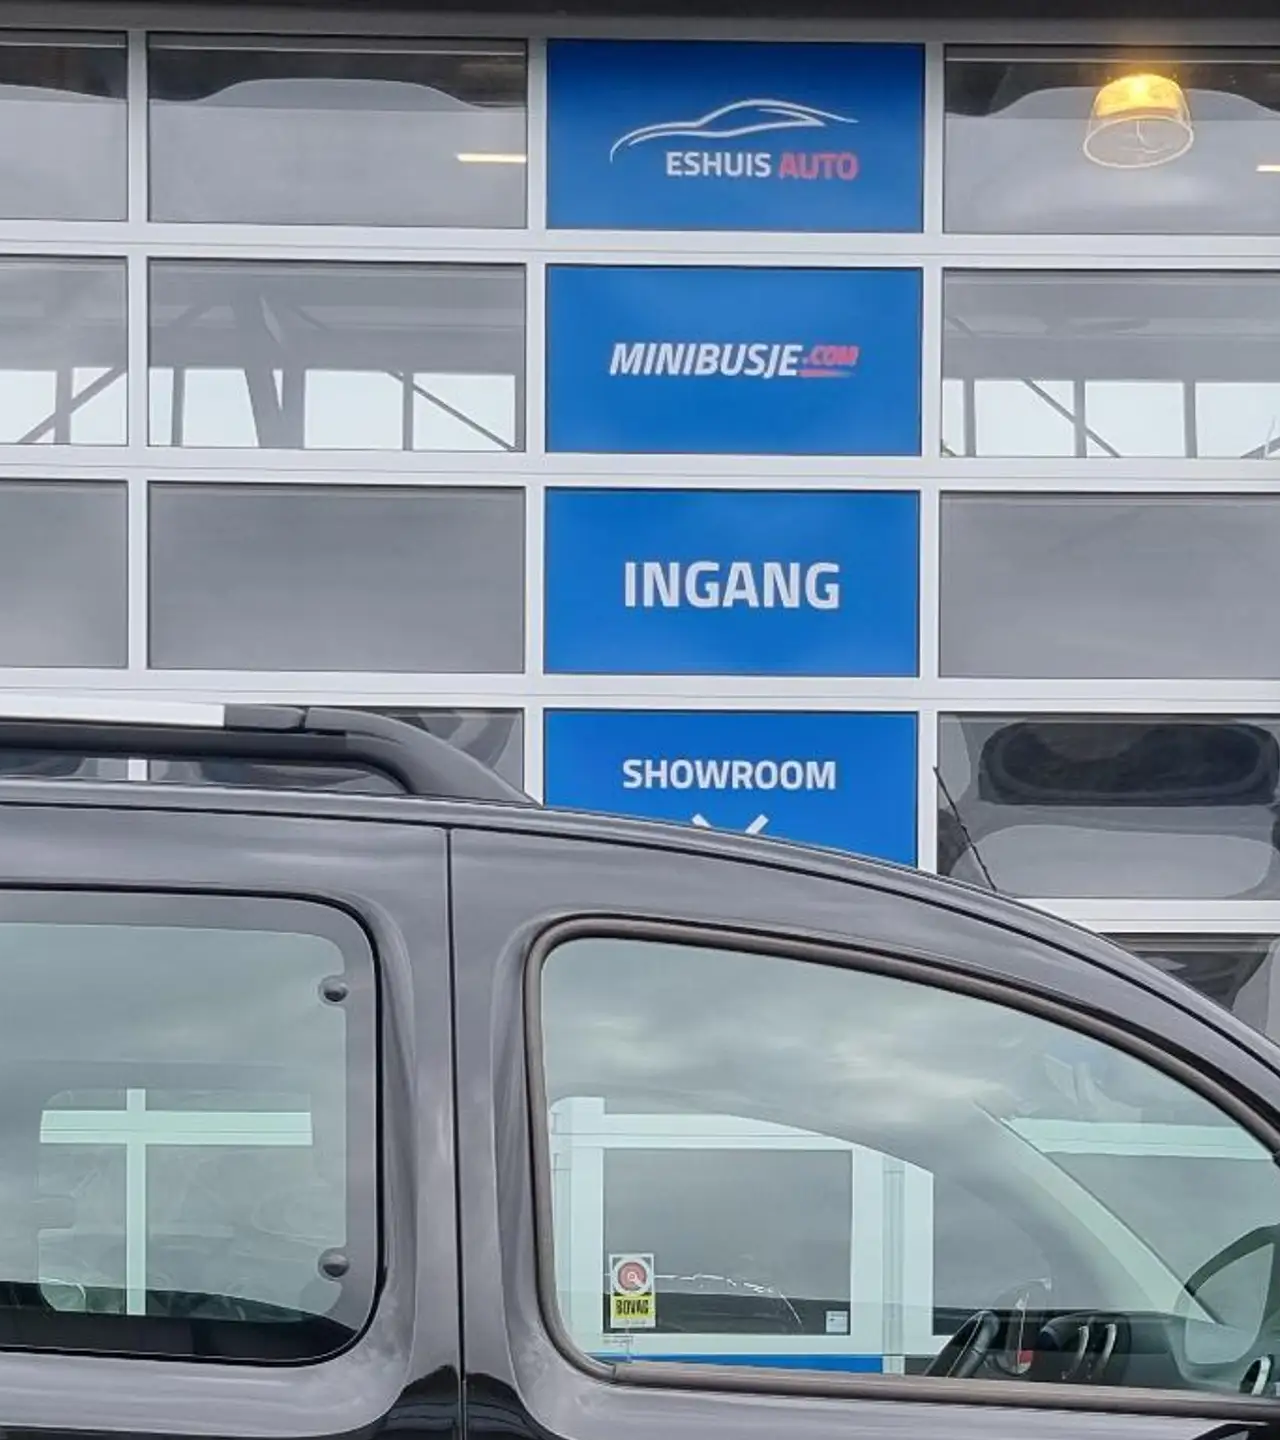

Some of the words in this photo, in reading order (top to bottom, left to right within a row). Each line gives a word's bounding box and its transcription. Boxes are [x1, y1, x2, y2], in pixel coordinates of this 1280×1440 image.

[665, 151, 772, 178] ESHUIS
[778, 151, 859, 180] AUTO
[609, 342, 859, 380] MINIBUSJE.COM
[624, 561, 840, 609] INGANG
[622, 758, 837, 791] SHOWROOM
